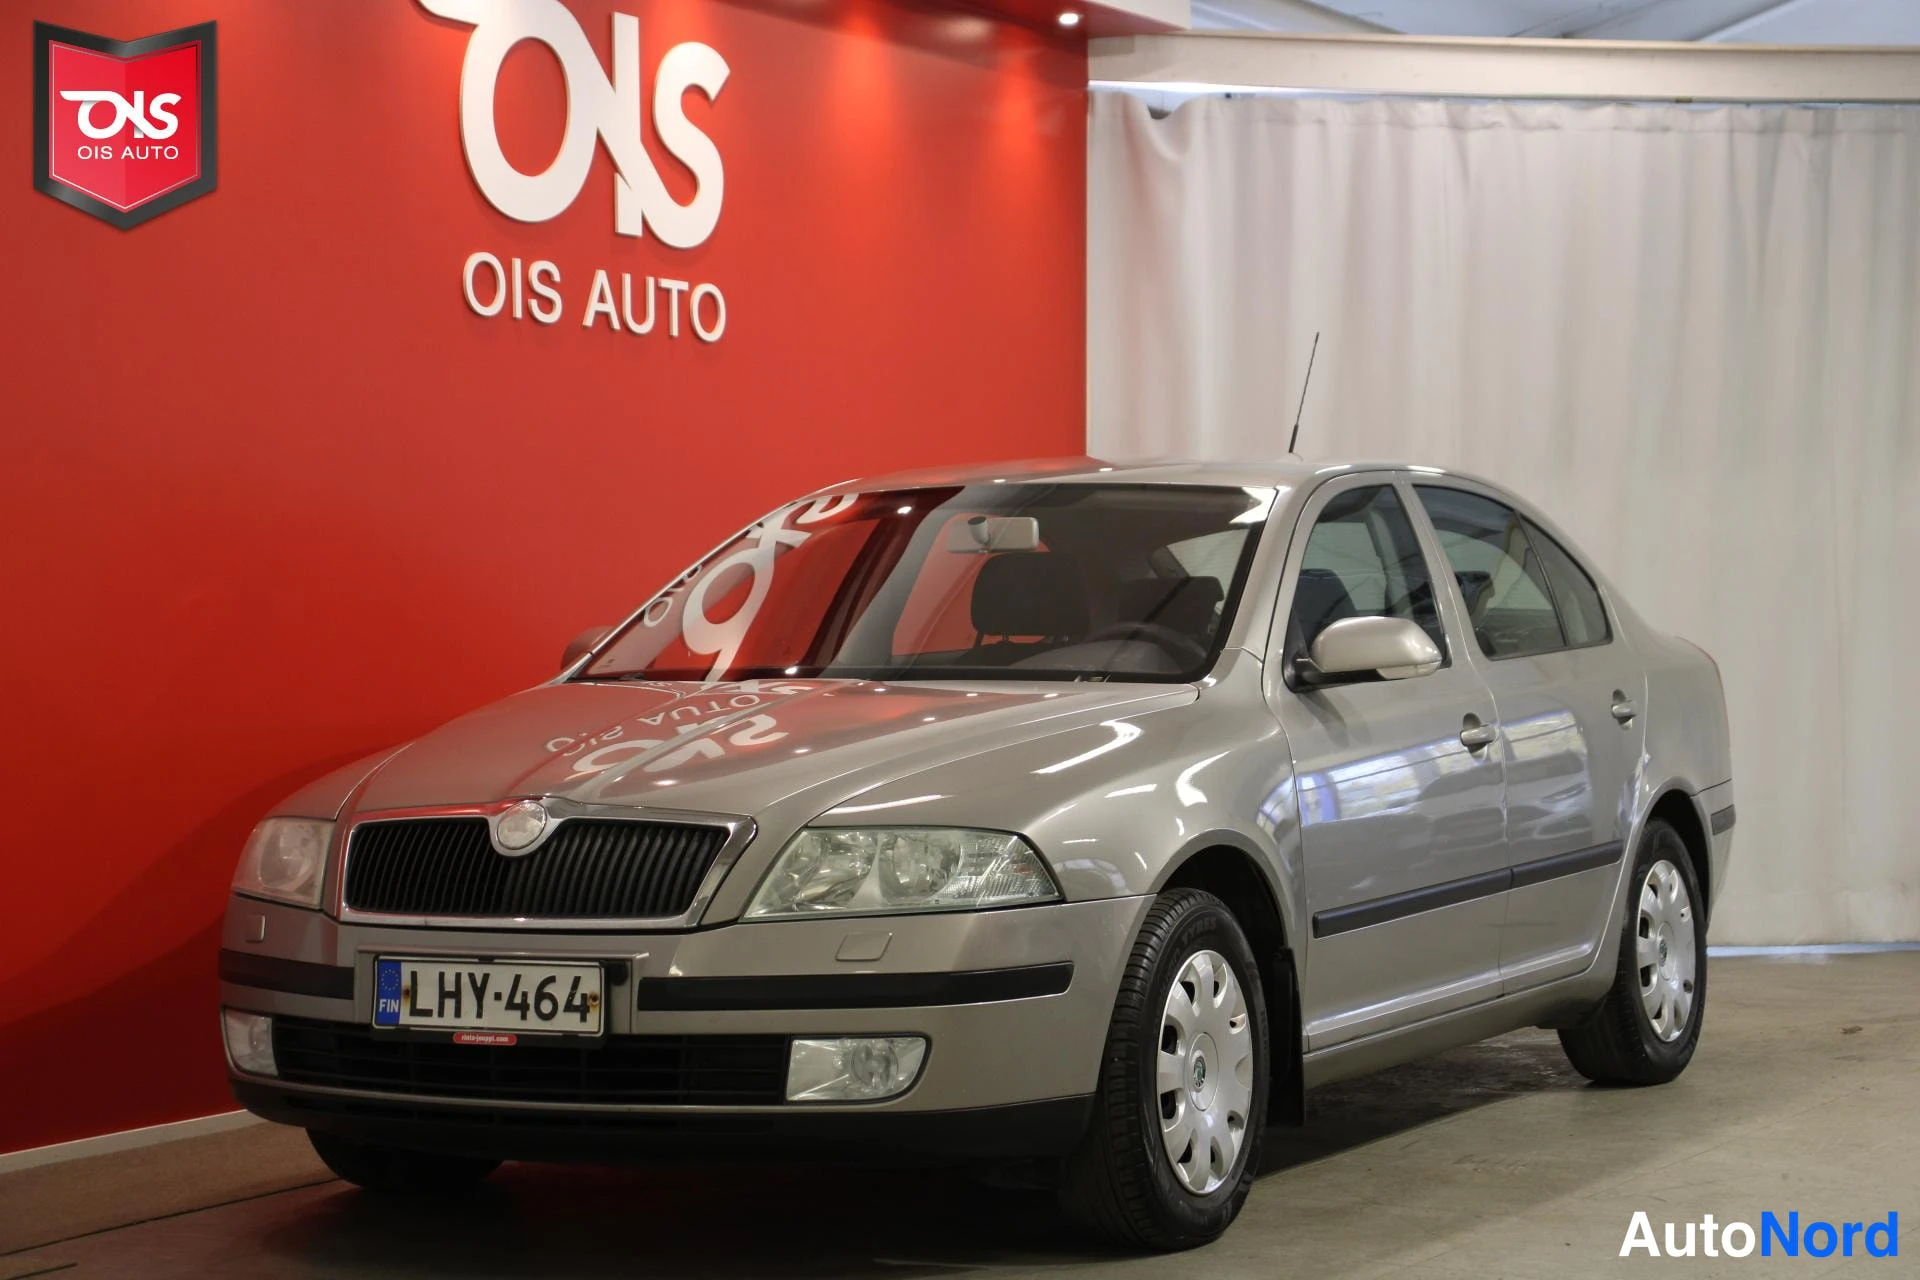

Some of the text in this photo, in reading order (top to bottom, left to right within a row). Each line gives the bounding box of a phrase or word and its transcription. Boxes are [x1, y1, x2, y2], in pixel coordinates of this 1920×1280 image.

[462, 251, 727, 343] OIS AUTO
[379, 998, 399, 1013] FIN
[409, 970, 591, 1023] LHY-464
